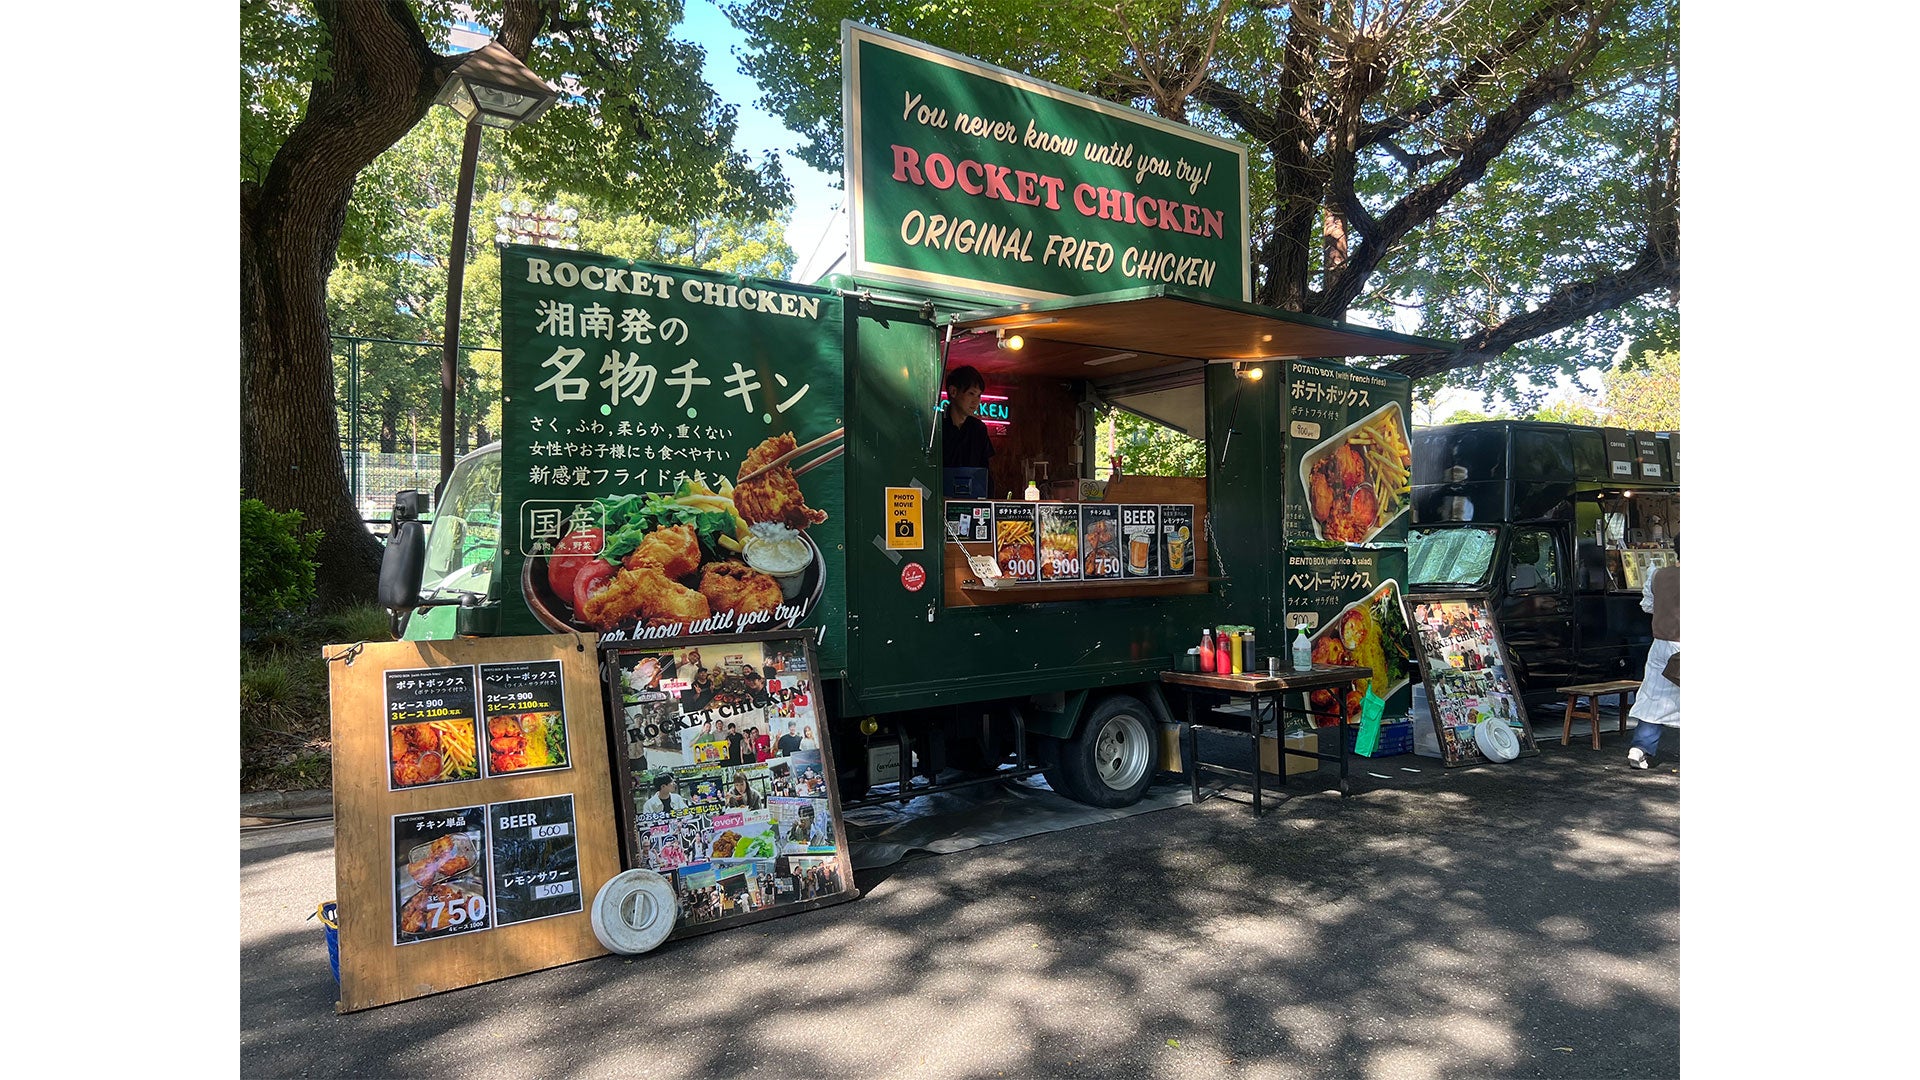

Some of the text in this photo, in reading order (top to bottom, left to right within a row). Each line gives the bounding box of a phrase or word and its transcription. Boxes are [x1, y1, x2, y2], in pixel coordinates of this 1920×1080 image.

[903, 91, 1213, 196] You never know until you try!
[890, 143, 1225, 240] ROCKET CHICKEN
[901, 209, 1217, 288] ORIGINAL FRIED CHICKEN
[526, 257, 821, 320] ROCKET CHICKEN
[535, 299, 689, 346] 湘南発の
[534, 345, 810, 414] 名物チキン
[1293, 363, 1320, 376] POTATO
[1320, 369, 1335, 378] BOX
[1350, 373, 1370, 384] french
[1291, 379, 1370, 408] ポテトボックス
[1291, 406, 1339, 420] ポテトフライ付き
[529, 441, 731, 462] 女性やお子様にも食べやすい
[529, 465, 727, 488] 新感覚フライドチキン
[530, 503, 597, 540] 国産
[1123, 509, 1156, 525] BEER
[1008, 559, 1035, 576] 900
[1052, 558, 1079, 574] 900
[1095, 558, 1120, 574] 750
[1289, 556, 1313, 566] BENTO
[1313, 557, 1325, 566] BOX
[1287, 571, 1373, 591] ベントーボックス
[633, 620, 684, 641] know
[689, 608, 735, 634] until
[737, 608, 772, 633] you
[774, 596, 809, 628] try!
[396, 677, 465, 690] ポテトボックス
[486, 671, 557, 682] ベントーボックス
[391, 699, 443, 711] 2ピース 900
[487, 692, 533, 702] 2ピース 900
[391, 710, 425, 721] 3ピース
[426, 708, 448, 718] 1100
[487, 703, 517, 712] 3ピース
[517, 701, 538, 710] 1100
[627, 708, 714, 744] ROCKET
[415, 816, 466, 831] チキン単品
[499, 813, 538, 830] BEER
[713, 815, 744, 827] every.
[538, 825, 561, 837] 600
[504, 870, 570, 888] レモンサワー
[543, 884, 564, 896] 500
[426, 895, 487, 929] 750
[469, 921, 484, 929] 1000
